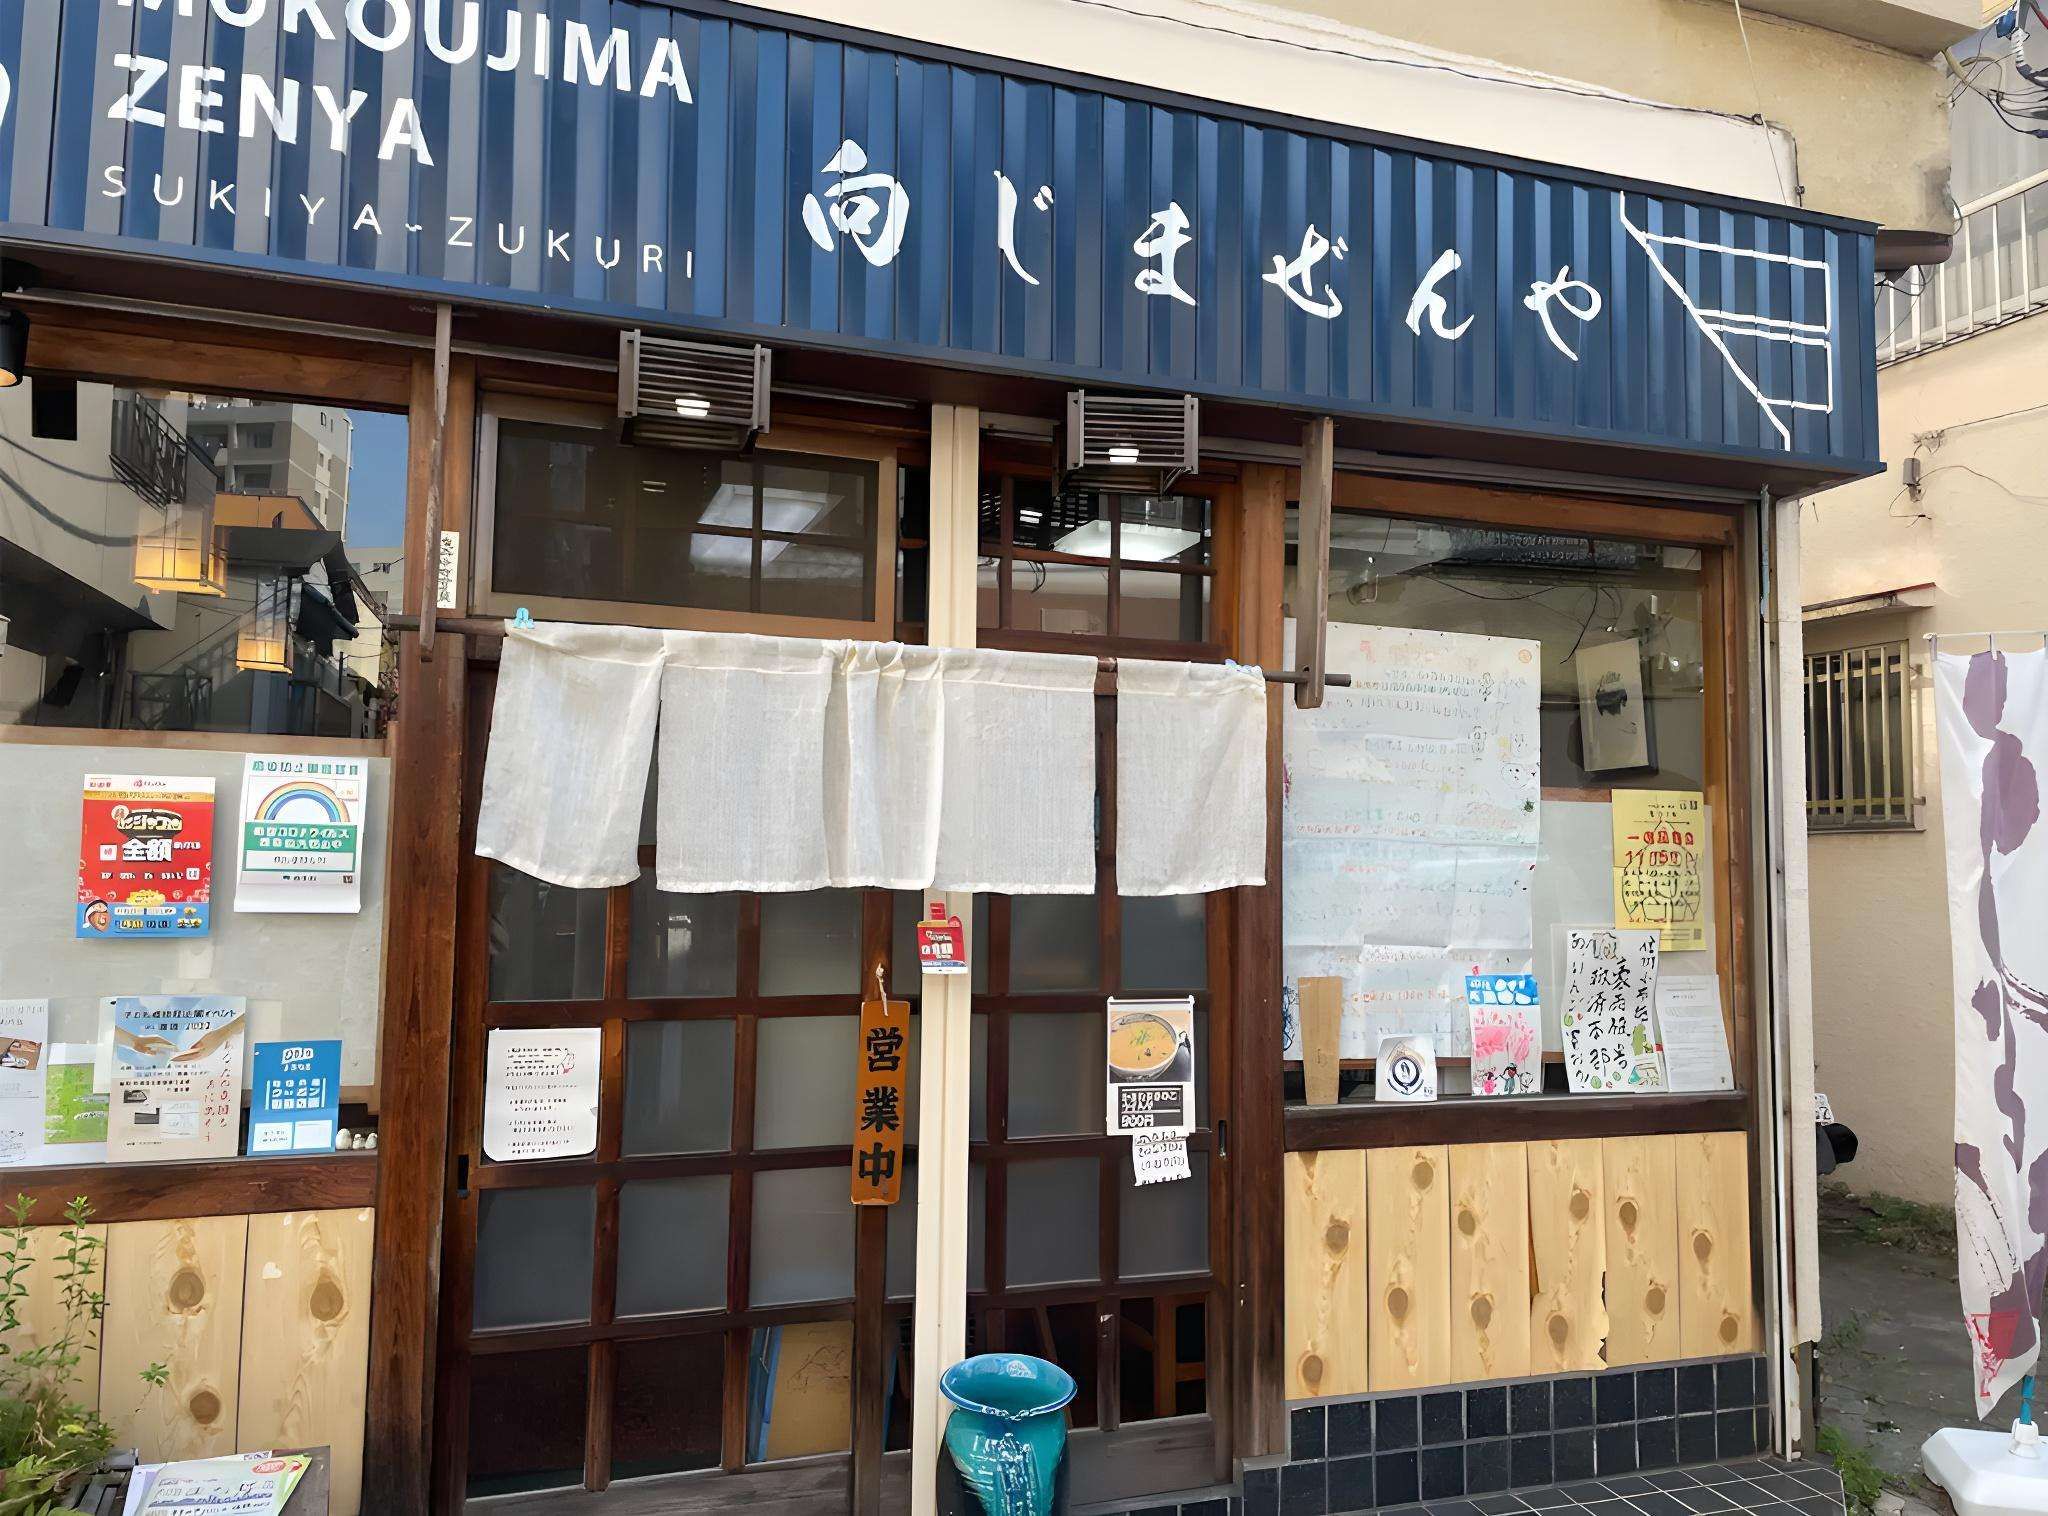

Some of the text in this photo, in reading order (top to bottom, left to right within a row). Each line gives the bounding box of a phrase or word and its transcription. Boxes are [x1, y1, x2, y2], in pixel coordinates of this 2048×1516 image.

[107, 53, 435, 166] ZENYA
[117, 0, 694, 104] KOUJIMA
[802, 138, 1602, 361] 向じまぜんや
[857, 1026, 904, 1187] 営業中
